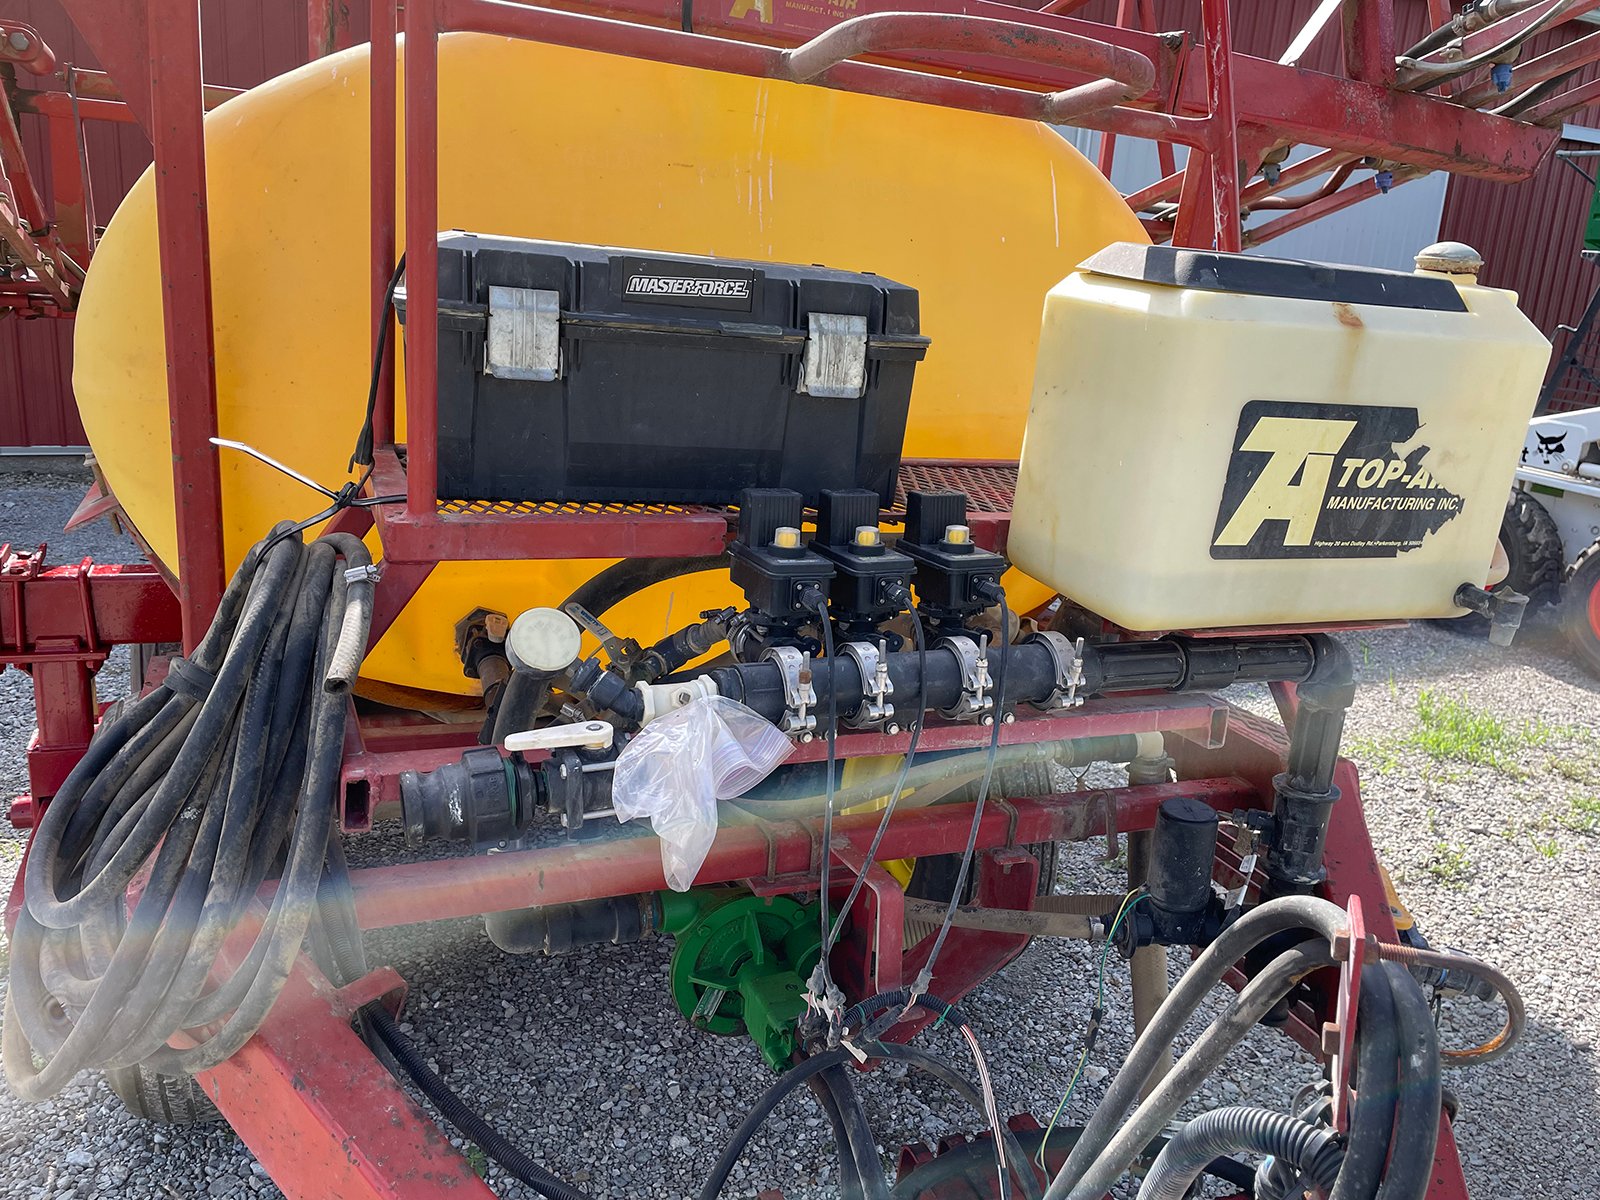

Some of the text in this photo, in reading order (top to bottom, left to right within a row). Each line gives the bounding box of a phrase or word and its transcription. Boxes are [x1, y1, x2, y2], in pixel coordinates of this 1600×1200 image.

[628, 276, 748, 297] MASTERFORCE
[1326, 496, 1459, 511] MANUFACTURING INC.
